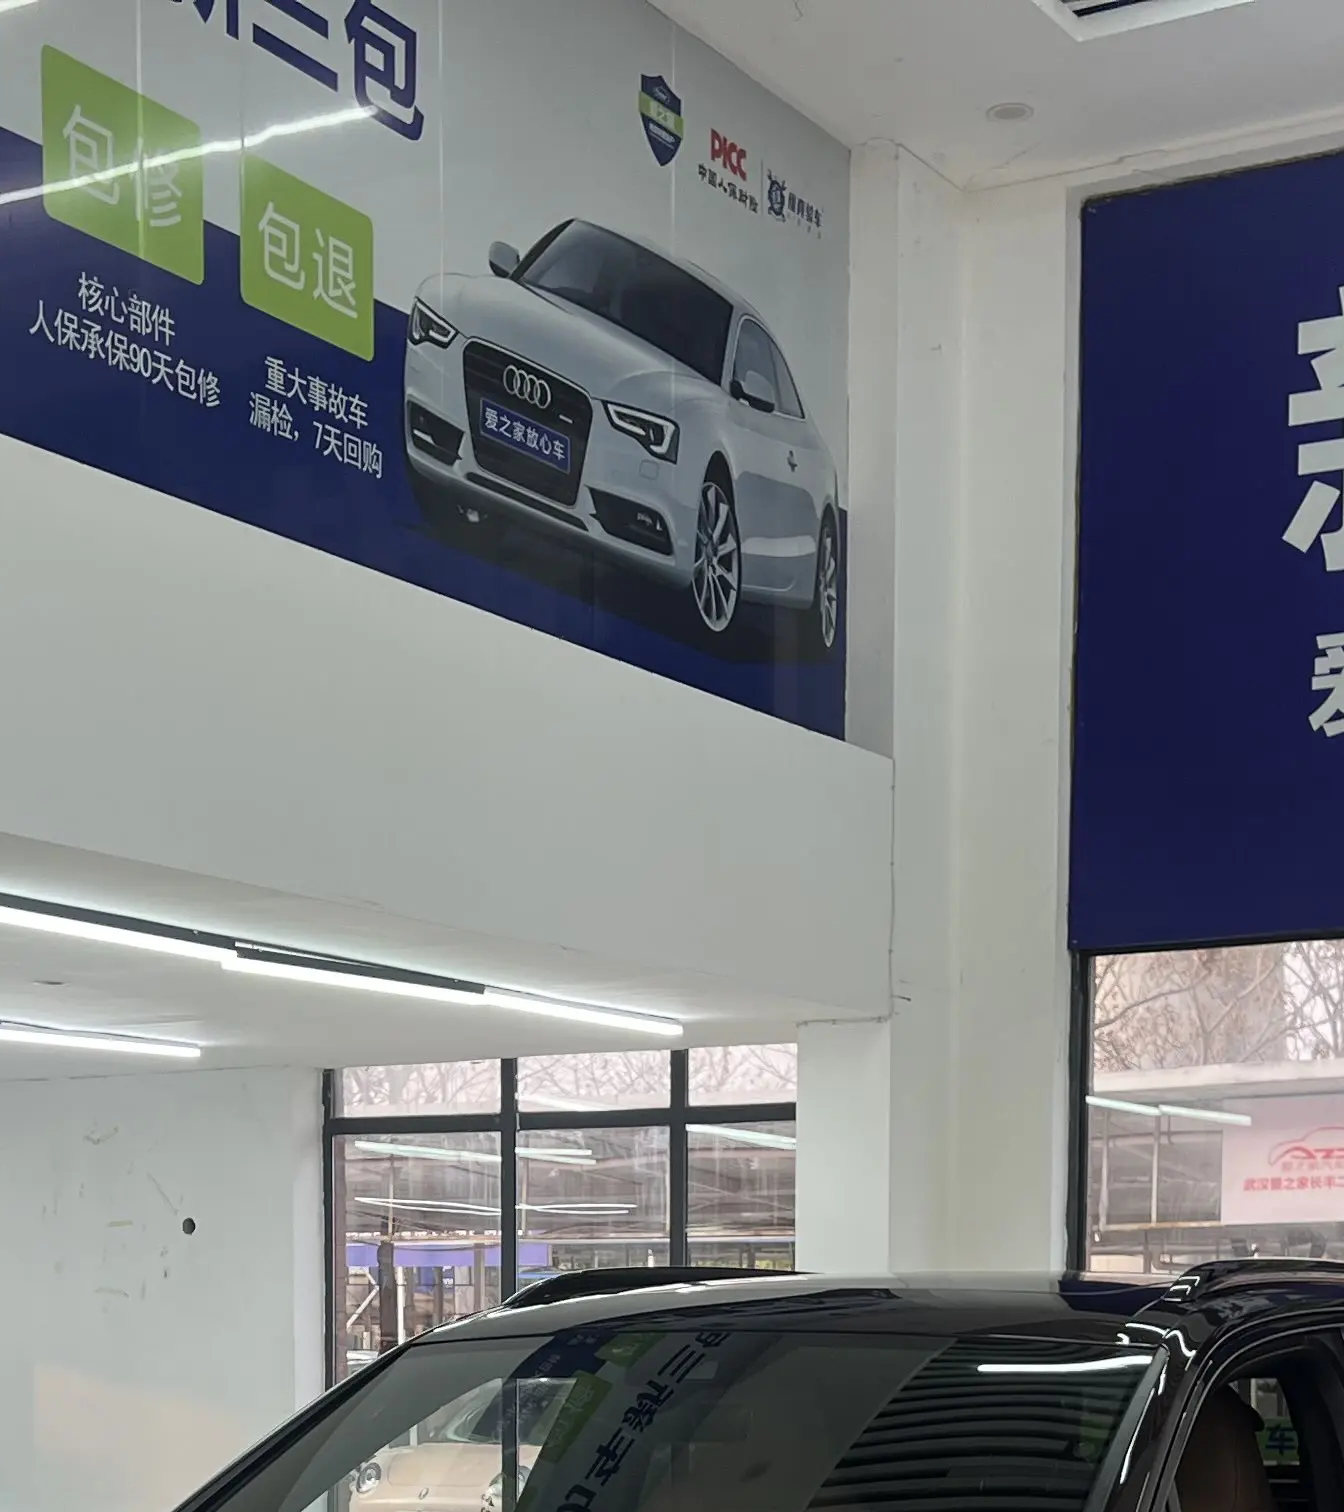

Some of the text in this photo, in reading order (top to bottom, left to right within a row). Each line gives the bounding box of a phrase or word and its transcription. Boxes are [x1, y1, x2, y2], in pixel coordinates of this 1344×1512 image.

[62, 104, 183, 228] 包修
[710, 127, 747, 182] PICC
[258, 201, 359, 319] 包退
[28, 299, 222, 408] 人保承保90天包修
[77, 271, 176, 347] 核心部件
[264, 355, 369, 430] 重大事故车
